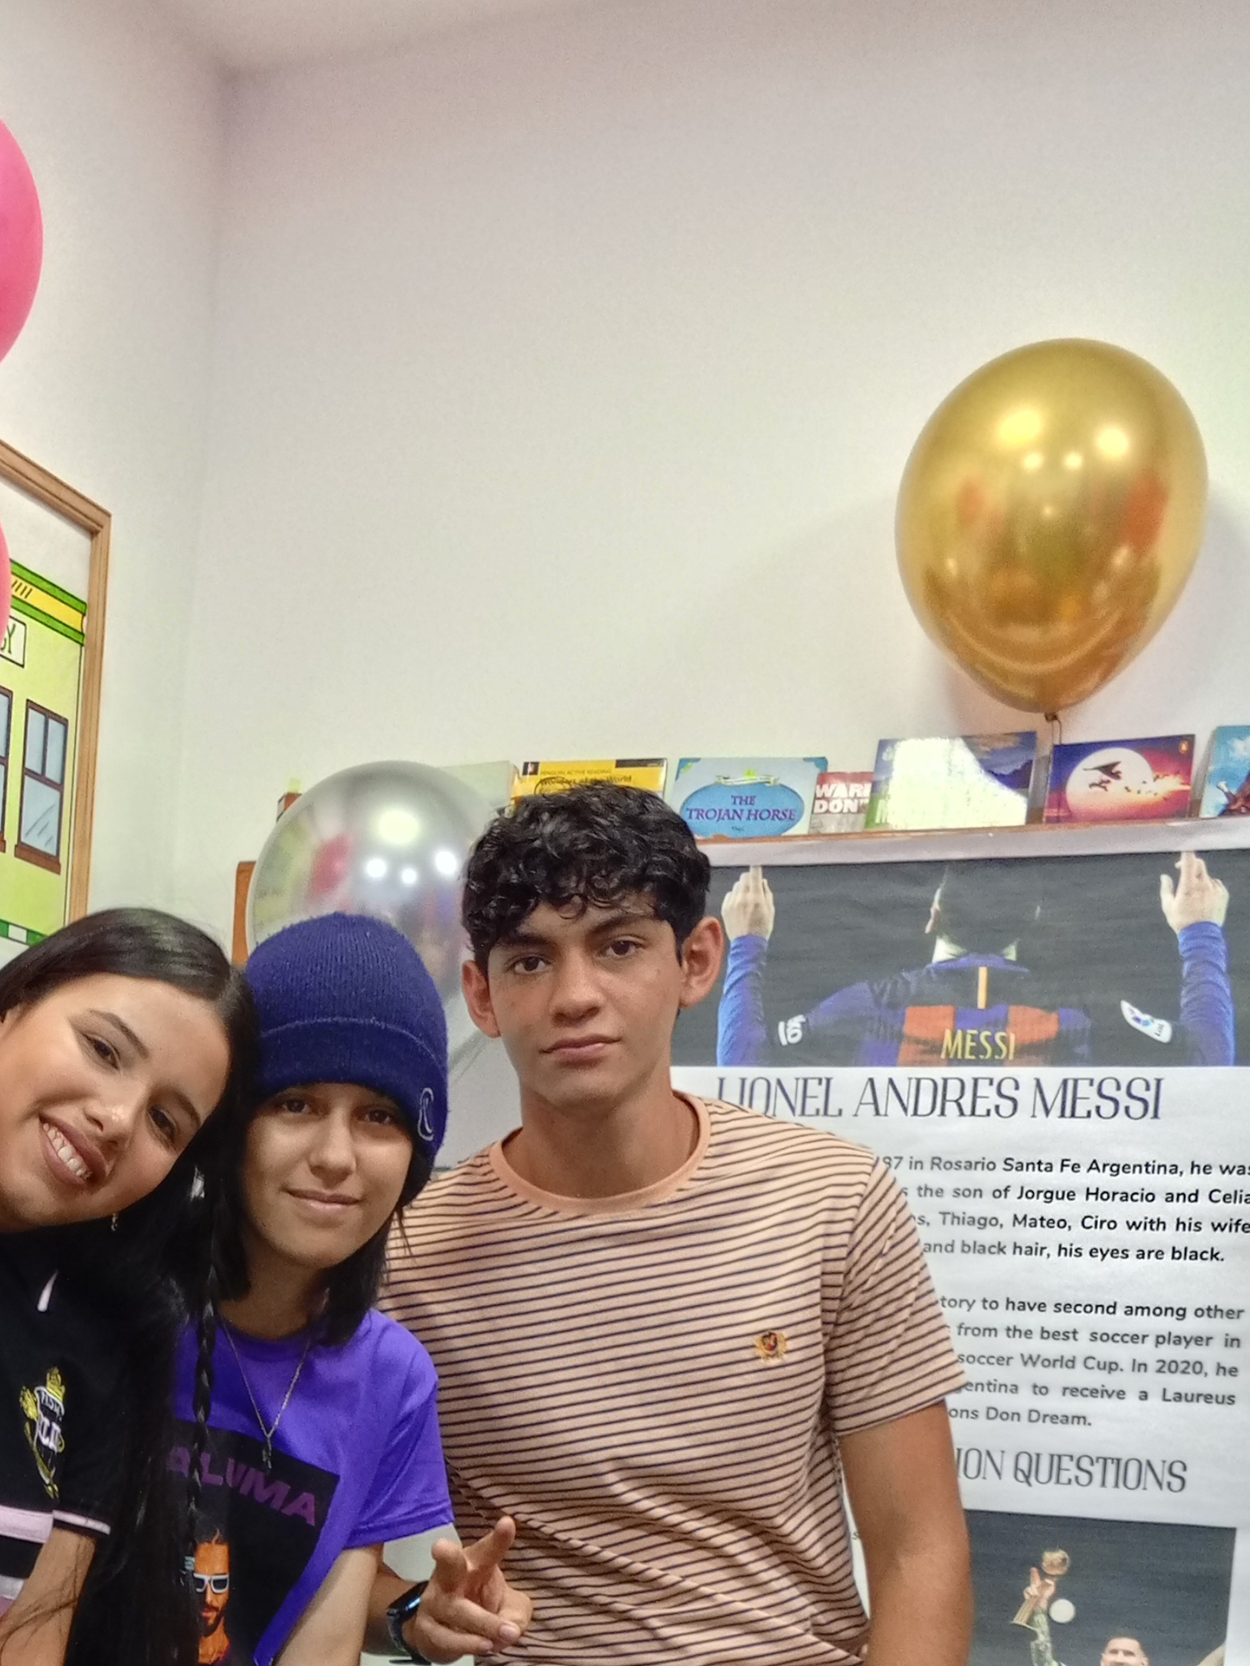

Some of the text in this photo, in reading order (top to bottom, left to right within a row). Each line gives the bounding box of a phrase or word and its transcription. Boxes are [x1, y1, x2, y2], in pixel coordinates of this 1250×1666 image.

[730, 795, 756, 806] THE
[685, 807, 797, 823] TROJAN HORSE
[941, 1027, 1015, 1061] MESSI
[852, 1076, 1020, 1119] ANDRES
[1030, 1076, 1164, 1121] MESSI
[908, 1156, 924, 1171] in
[930, 1156, 997, 1172] Rosario
[1002, 1157, 1054, 1173] Santa
[1060, 1158, 1081, 1174] Fe
[1086, 1158, 1184, 1178] Argentina,
[1190, 1160, 1213, 1176] he
[916, 1184, 944, 1198] the
[952, 1187, 983, 1199] son
[992, 1185, 1011, 1200] of
[1017, 1186, 1077, 1205] Jorgue
[1085, 1186, 1157, 1203] Horacio
[1165, 1188, 1200, 1204] and
[938, 1211, 1004, 1231] Thiago,
[1012, 1213, 1072, 1231] Mateo,
[1080, 1214, 1118, 1231] Ciro
[1126, 1216, 1167, 1232] with
[1175, 1217, 1203, 1233] his
[1210, 1217, 1250, 1234] wife
[923, 1239, 1225, 1262] and black hair, his eyes are black.
[981, 1296, 1000, 1311] to
[1005, 1296, 1047, 1313] have
[1053, 1300, 1117, 1316] second
[1123, 1304, 1187, 1321] among
[1193, 1304, 1245, 1320] other
[956, 1322, 1241, 1349] from the best soccer player in
[957, 1352, 1239, 1378] soccer World Cup. In 2020, he
[1031, 1383, 1049, 1396] to
[1061, 1384, 1126, 1401] receive
[1138, 1389, 1149, 1402] a
[1161, 1387, 1236, 1406] Laureus
[986, 1406, 1021, 1422] Don
[1027, 1409, 1092, 1427] Dream.
[1013, 1450, 1188, 1494] QUESTIONS
